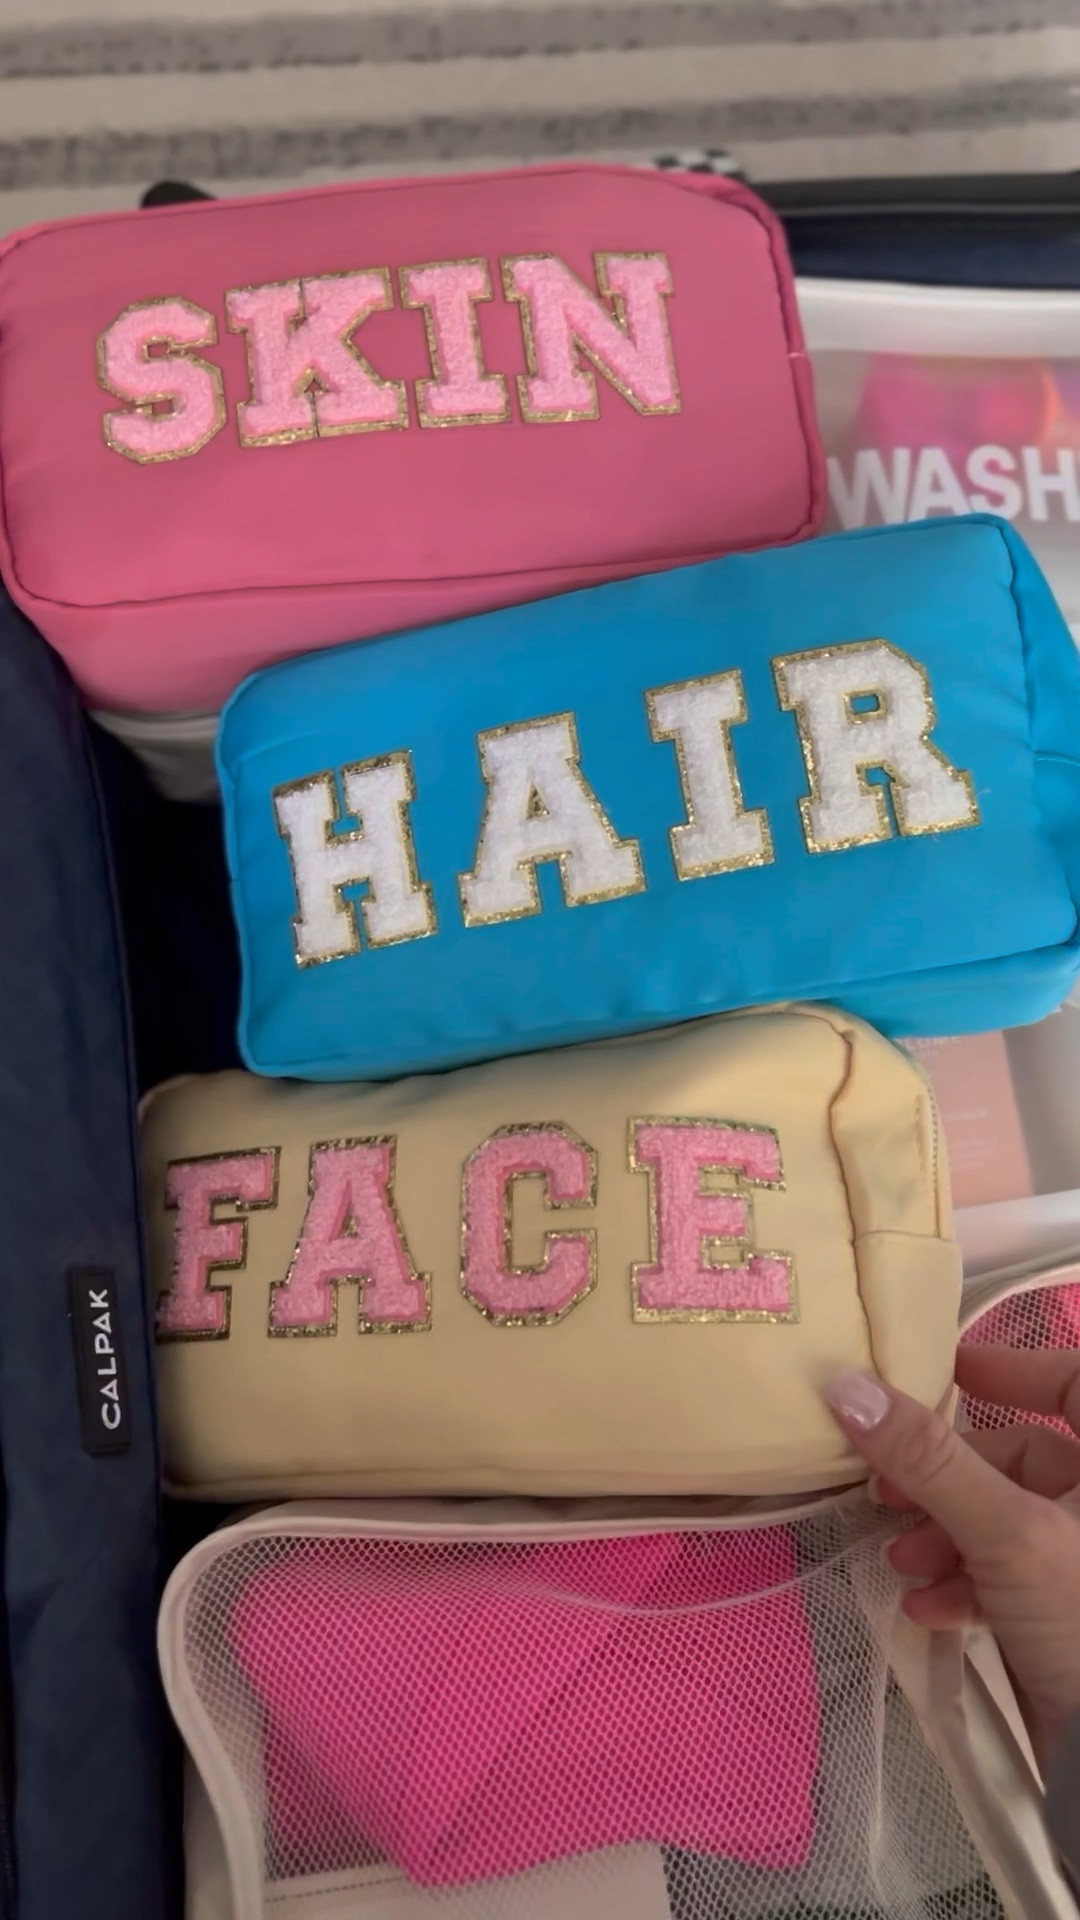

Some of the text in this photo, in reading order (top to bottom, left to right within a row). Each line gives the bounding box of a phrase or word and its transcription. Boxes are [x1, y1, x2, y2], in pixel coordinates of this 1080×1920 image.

[97, 251, 682, 464] SKIN
[829, 446, 1080, 529] WASH
[274, 638, 980, 967] HAIR
[155, 1116, 798, 1342] FACE
[88, 1288, 122, 1430] CALPAK
